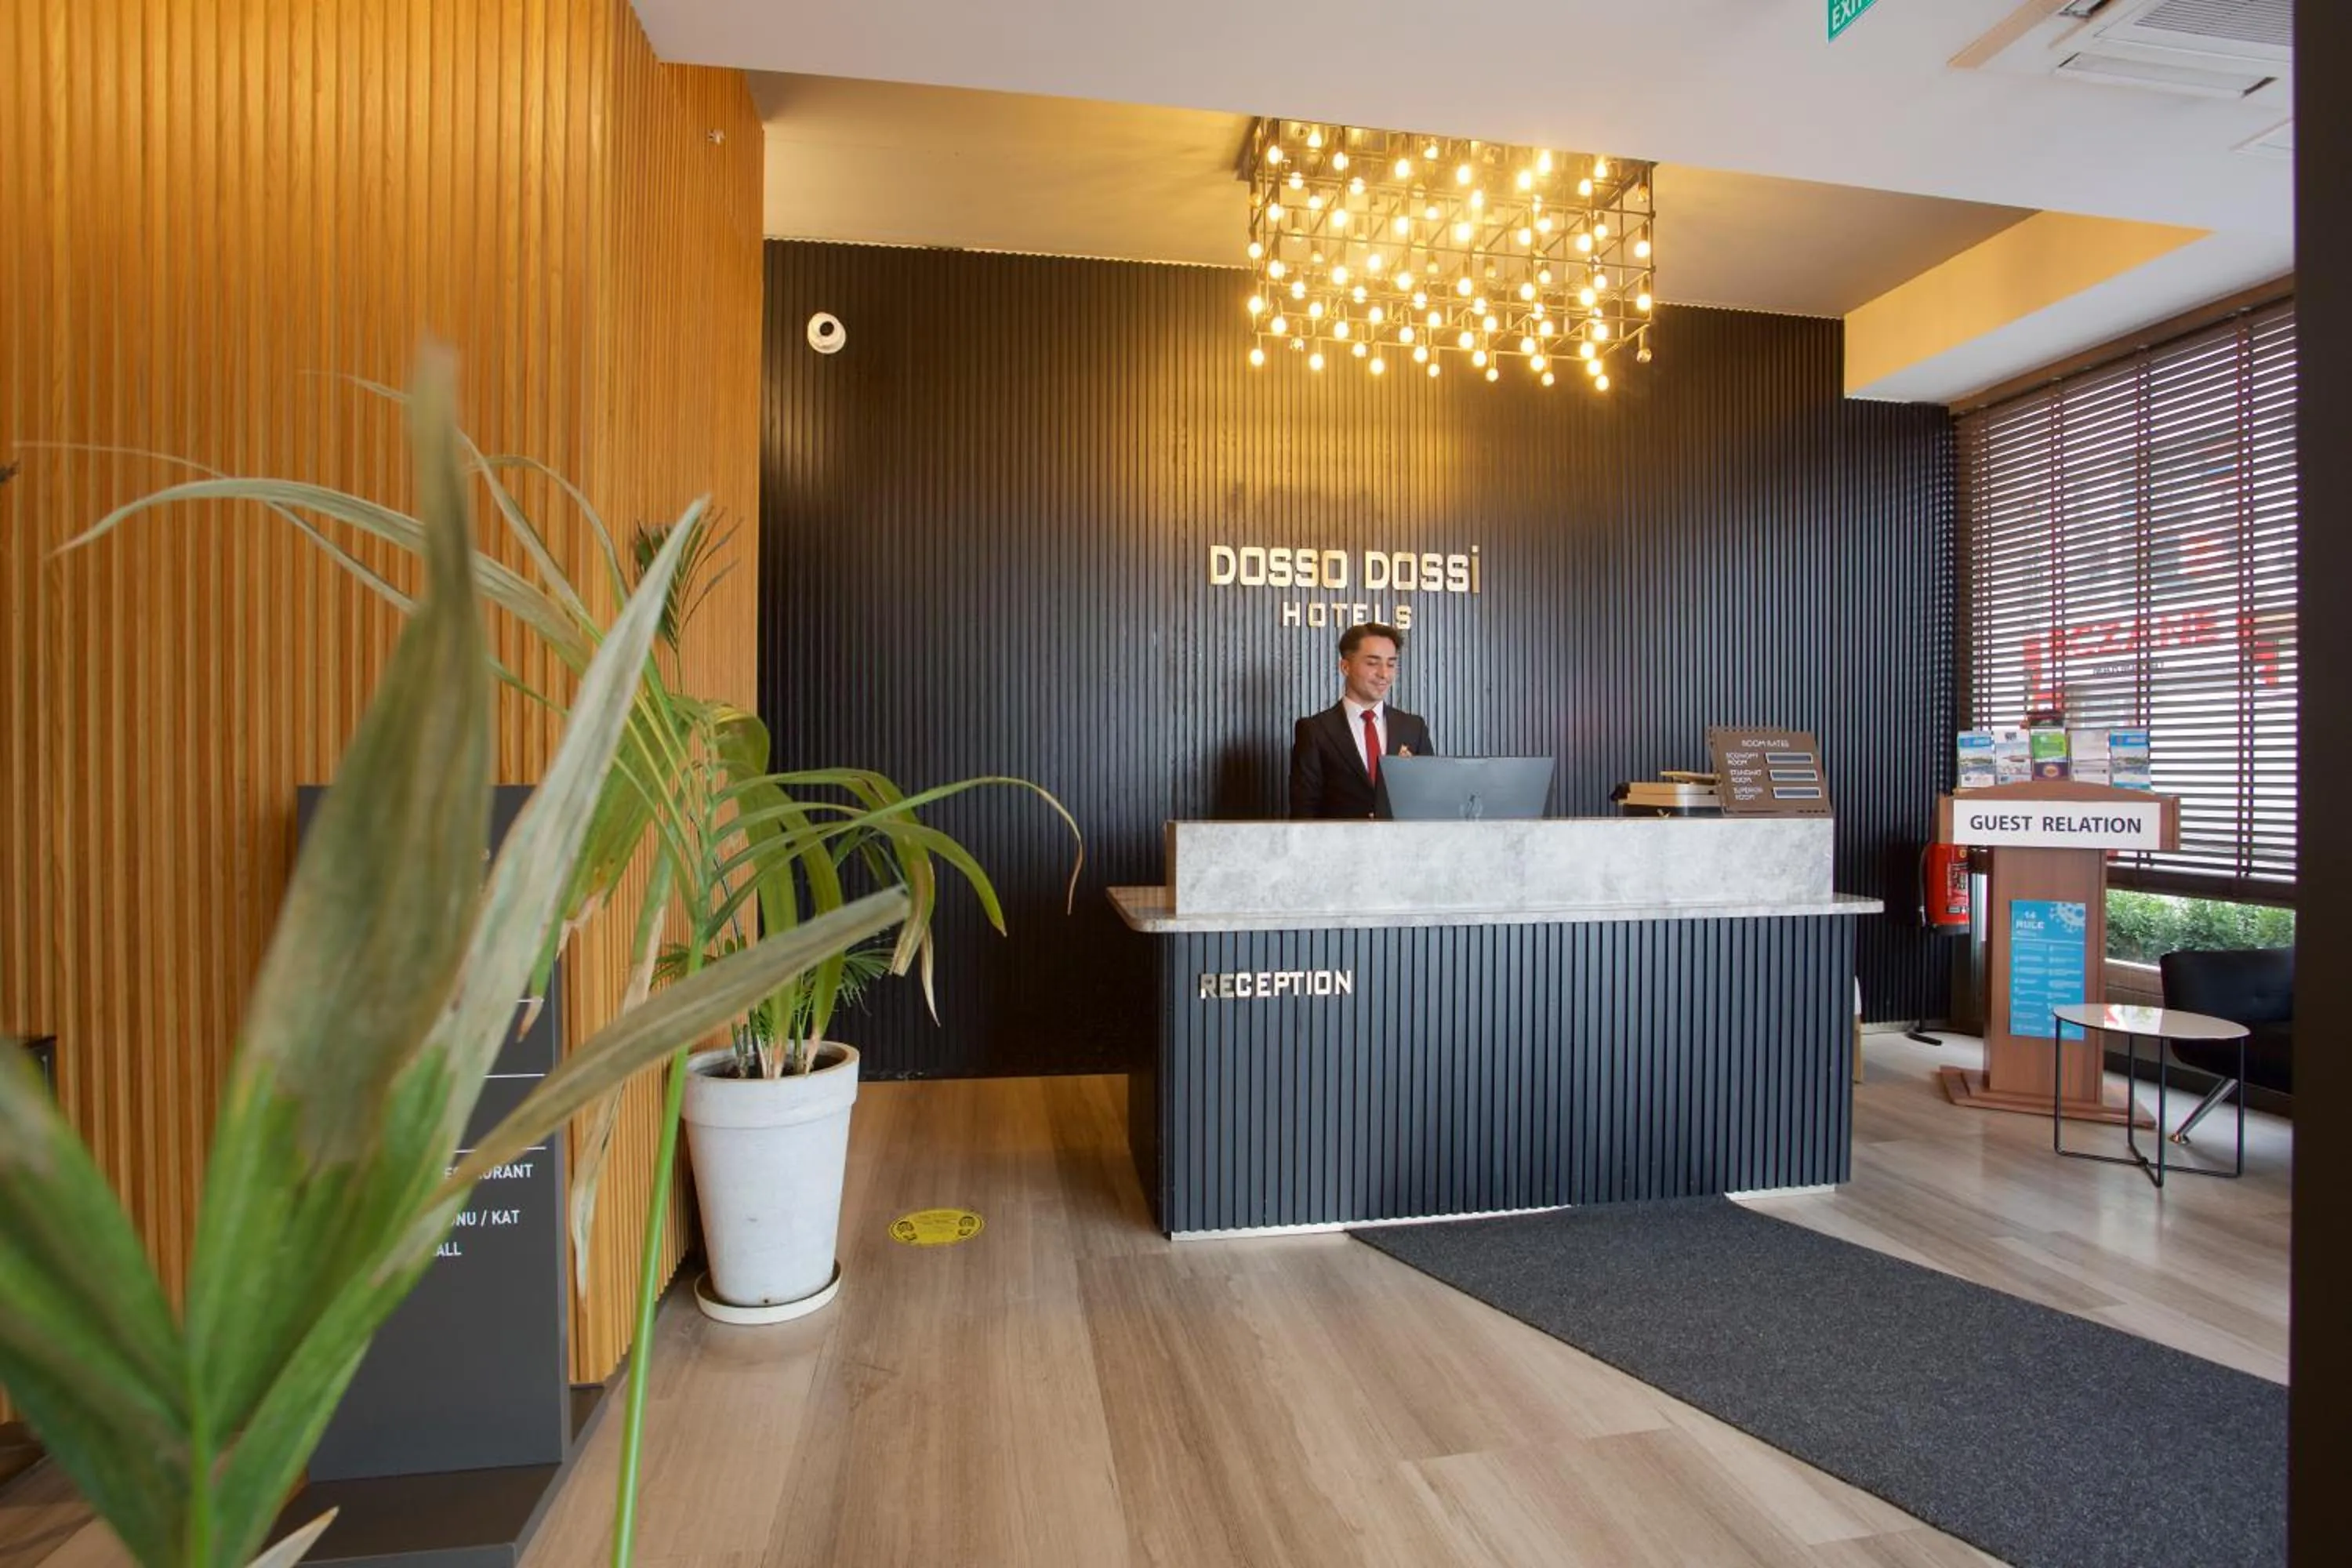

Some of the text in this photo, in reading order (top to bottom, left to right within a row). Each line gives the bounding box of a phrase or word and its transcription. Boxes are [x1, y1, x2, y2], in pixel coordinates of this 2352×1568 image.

[1210, 545, 1348, 589] DOSSO
[1283, 601, 1412, 630] HOTELS
[1969, 815, 2141, 833] GUEST RELATION
[1200, 970, 1352, 999] RECEPTION
[492, 1210, 521, 1225] KAT
